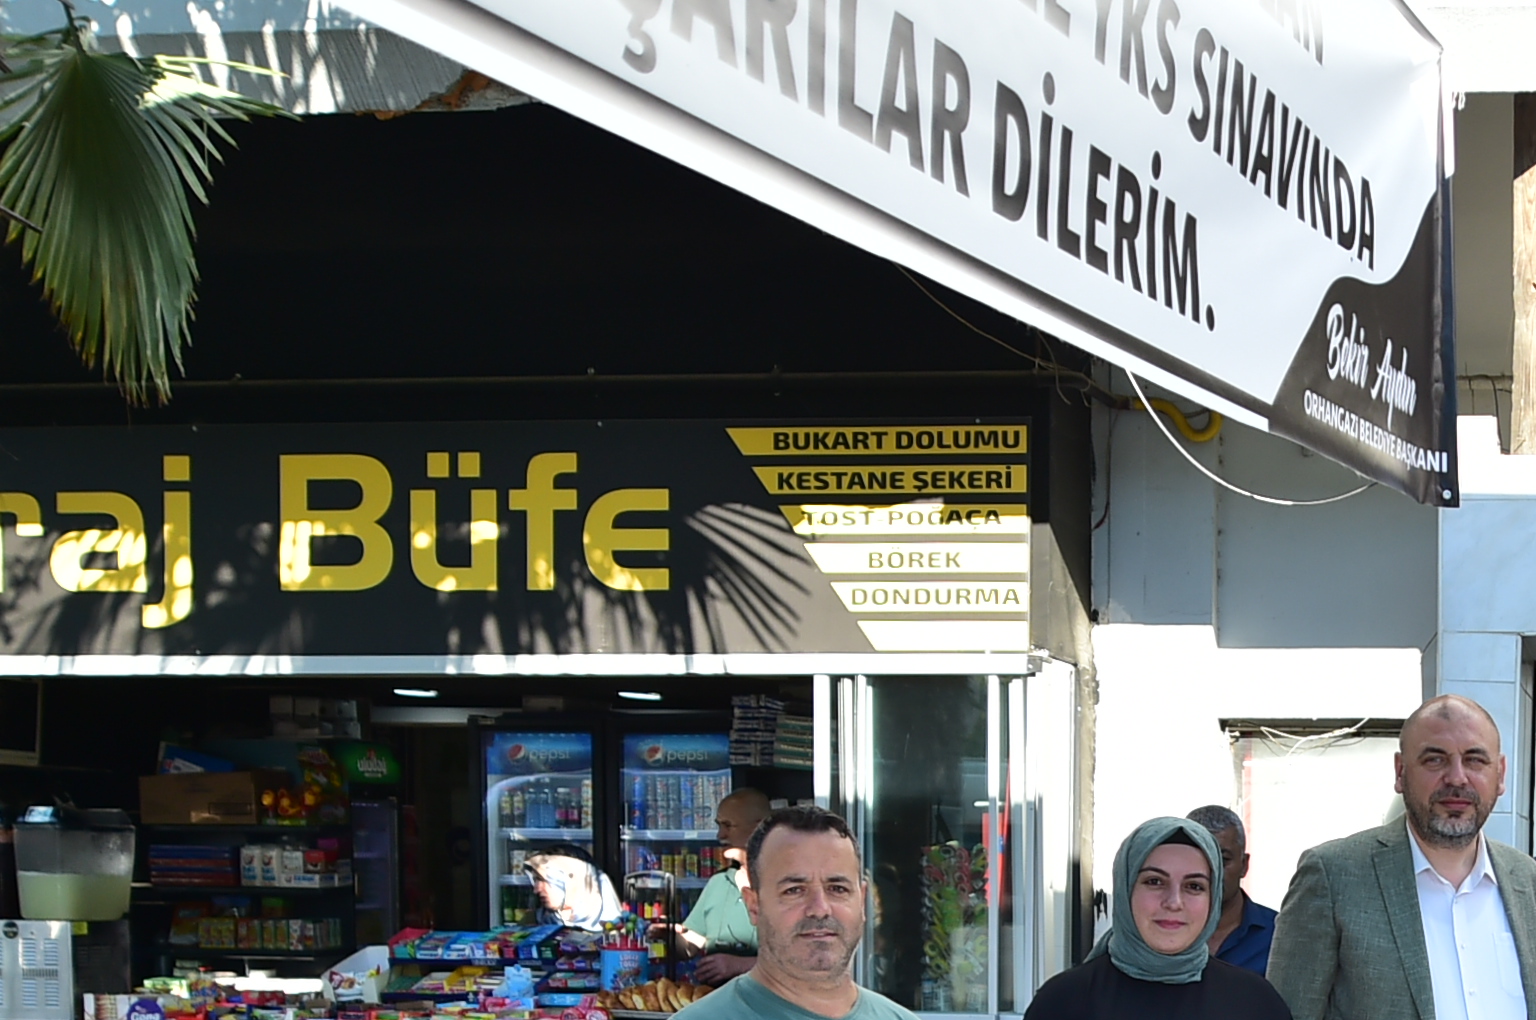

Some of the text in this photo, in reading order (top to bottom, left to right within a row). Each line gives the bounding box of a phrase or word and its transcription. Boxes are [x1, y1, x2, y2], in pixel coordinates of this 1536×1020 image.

[1094, 0, 1375, 271] YKS SINAVINDA
[623, 0, 1216, 332] RILAR DİLERİM.
[1326, 303, 1369, 390] Bekir
[773, 430, 1021, 451] BUKART DOLUMU
[1304, 389, 1448, 473] ORHANGAZİ BELEDİYE BAŞKANI
[777, 465, 1013, 492] KESTANE ŞEKERİ
[279, 452, 669, 591] Büfe
[868, 546, 961, 569] BÖREK
[851, 588, 1021, 606] DONDURMA
[529, 748, 570, 764] pepsi
[667, 748, 708, 764] pepsi
